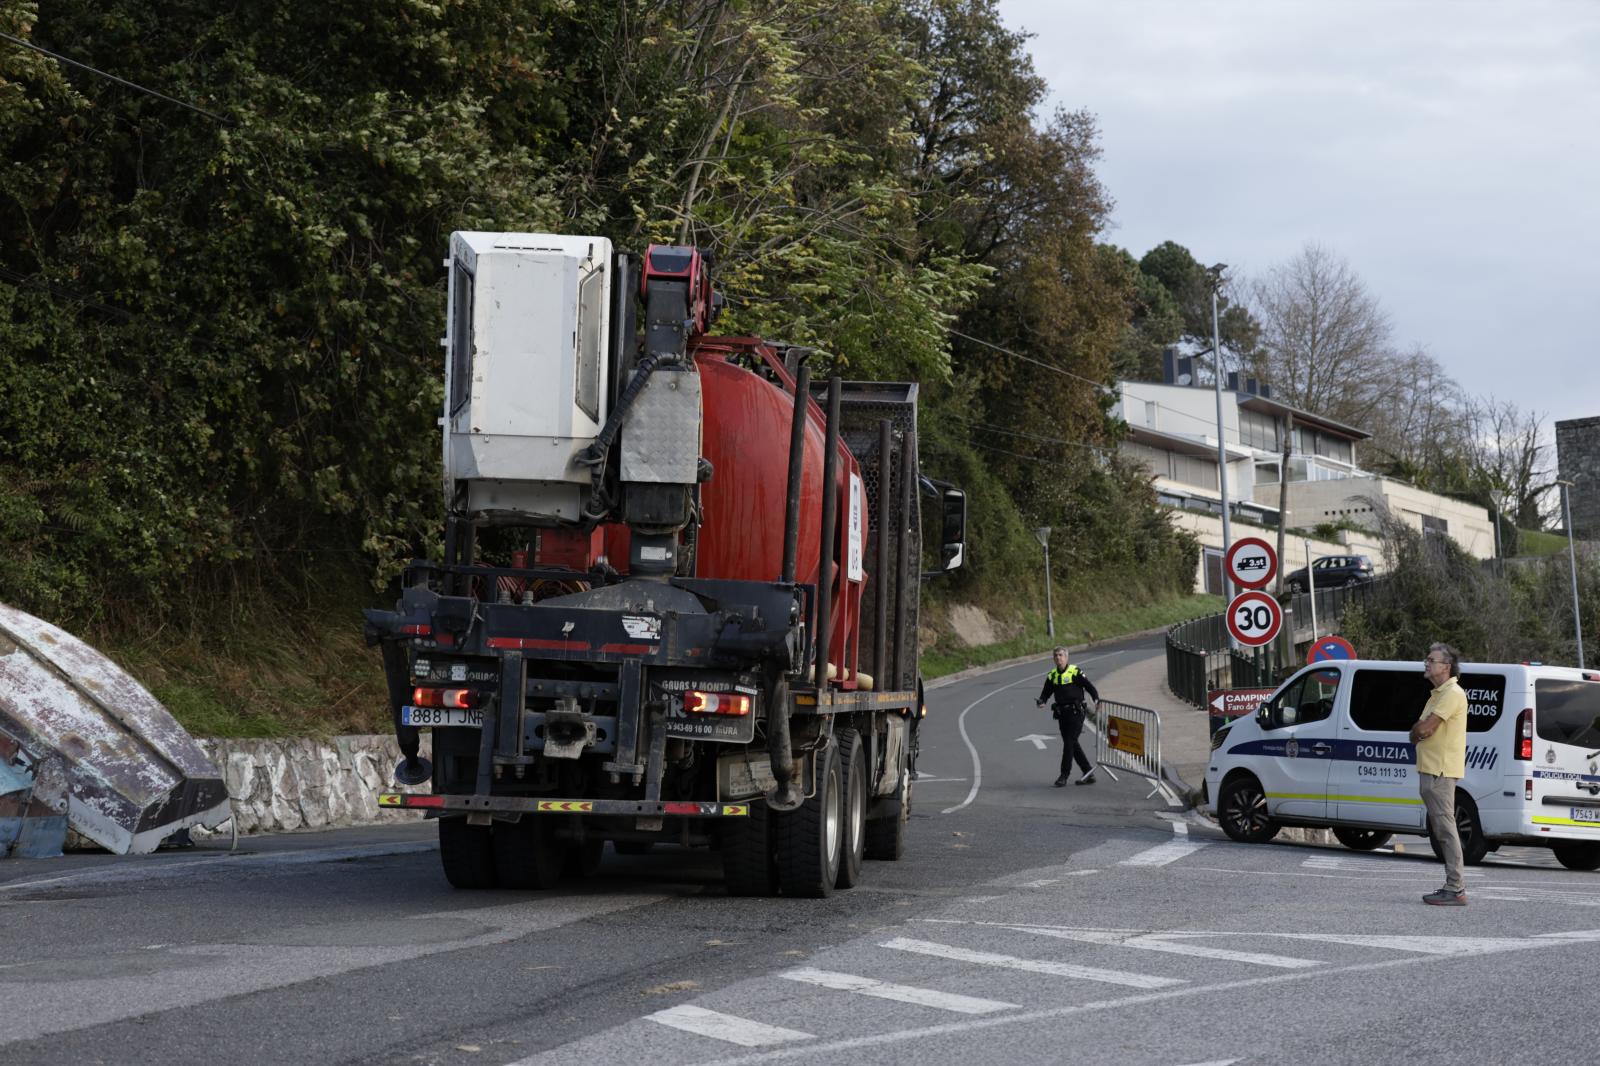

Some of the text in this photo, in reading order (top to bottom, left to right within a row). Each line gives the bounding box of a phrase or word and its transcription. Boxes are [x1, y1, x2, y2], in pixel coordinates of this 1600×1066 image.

[1238, 606, 1271, 631] 30
[662, 680, 734, 692] GRUAS Y MONTA
[1465, 688, 1499, 701] KETAK
[1227, 703, 1245, 711] Faro
[1467, 703, 1497, 717] ADOS
[412, 708, 451, 724] 8881
[694, 724, 703, 733] 16
[703, 725, 713, 734] 00
[1356, 744, 1409, 760] POLIZIA
[1363, 766, 1407, 778] 943 111 313
[1564, 773, 1582, 781] LOCAL
[1575, 809, 1593, 820] 7543
